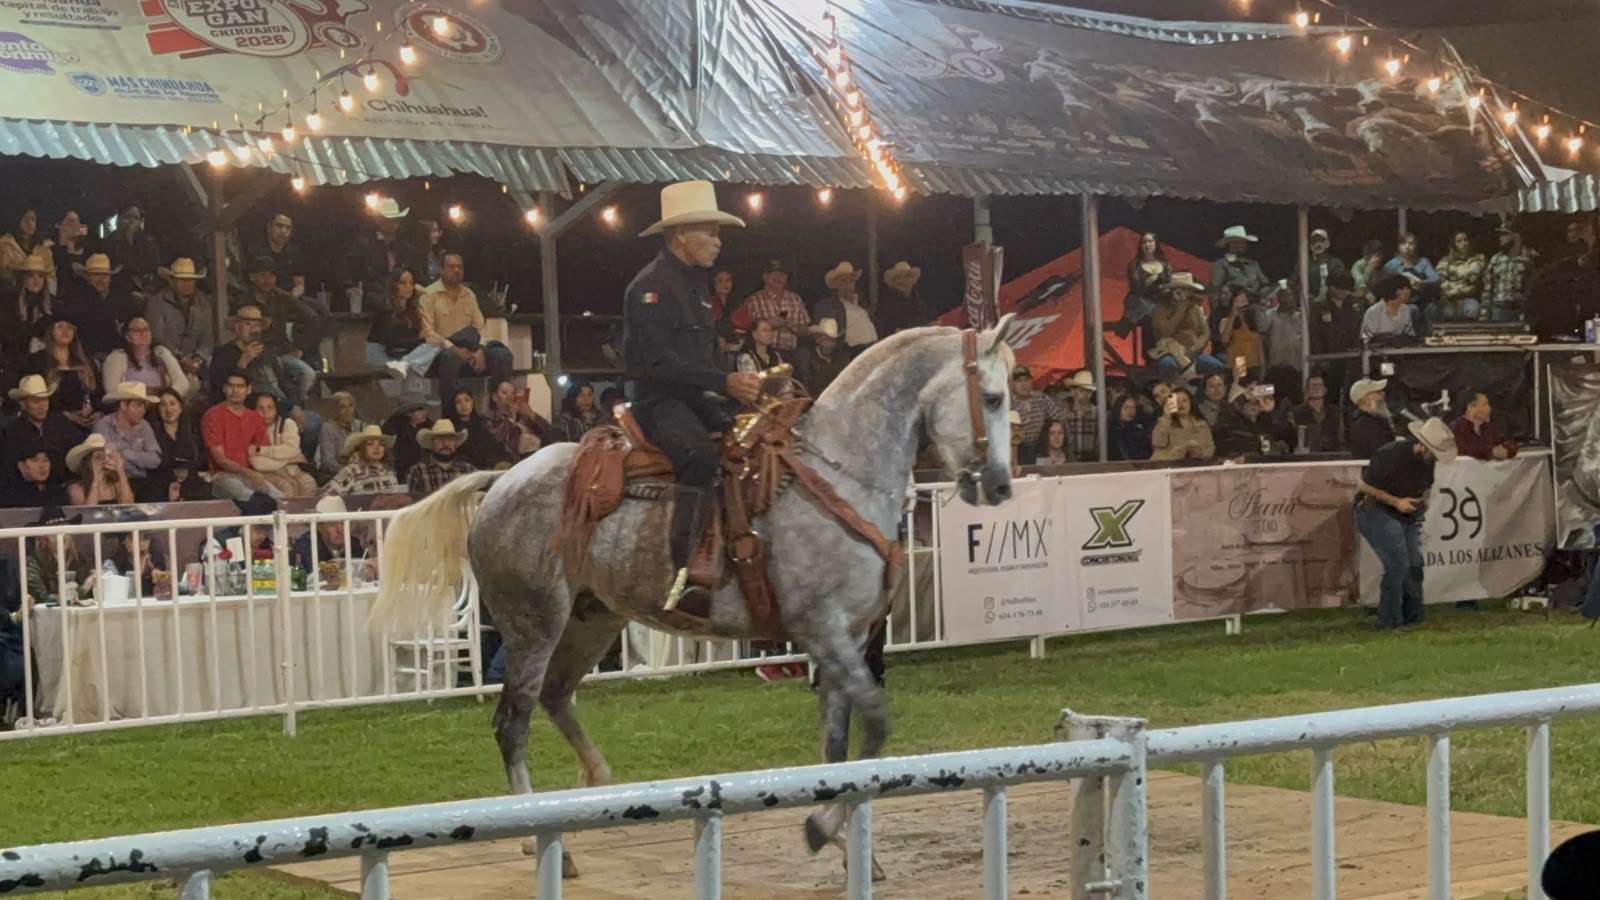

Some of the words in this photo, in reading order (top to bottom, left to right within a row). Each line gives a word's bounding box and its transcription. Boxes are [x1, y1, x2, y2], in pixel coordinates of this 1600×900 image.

[188, 0, 258, 14] EXPO
[208, 10, 267, 26] GAN
[210, 25, 292, 38] CHIHUAHUA
[0, 40, 42, 51] ento
[235, 34, 287, 48] 2026
[0, 50, 80, 65] onmigo
[367, 99, 489, 118] Chihuahua!
[1449, 550, 1473, 565] LOS
